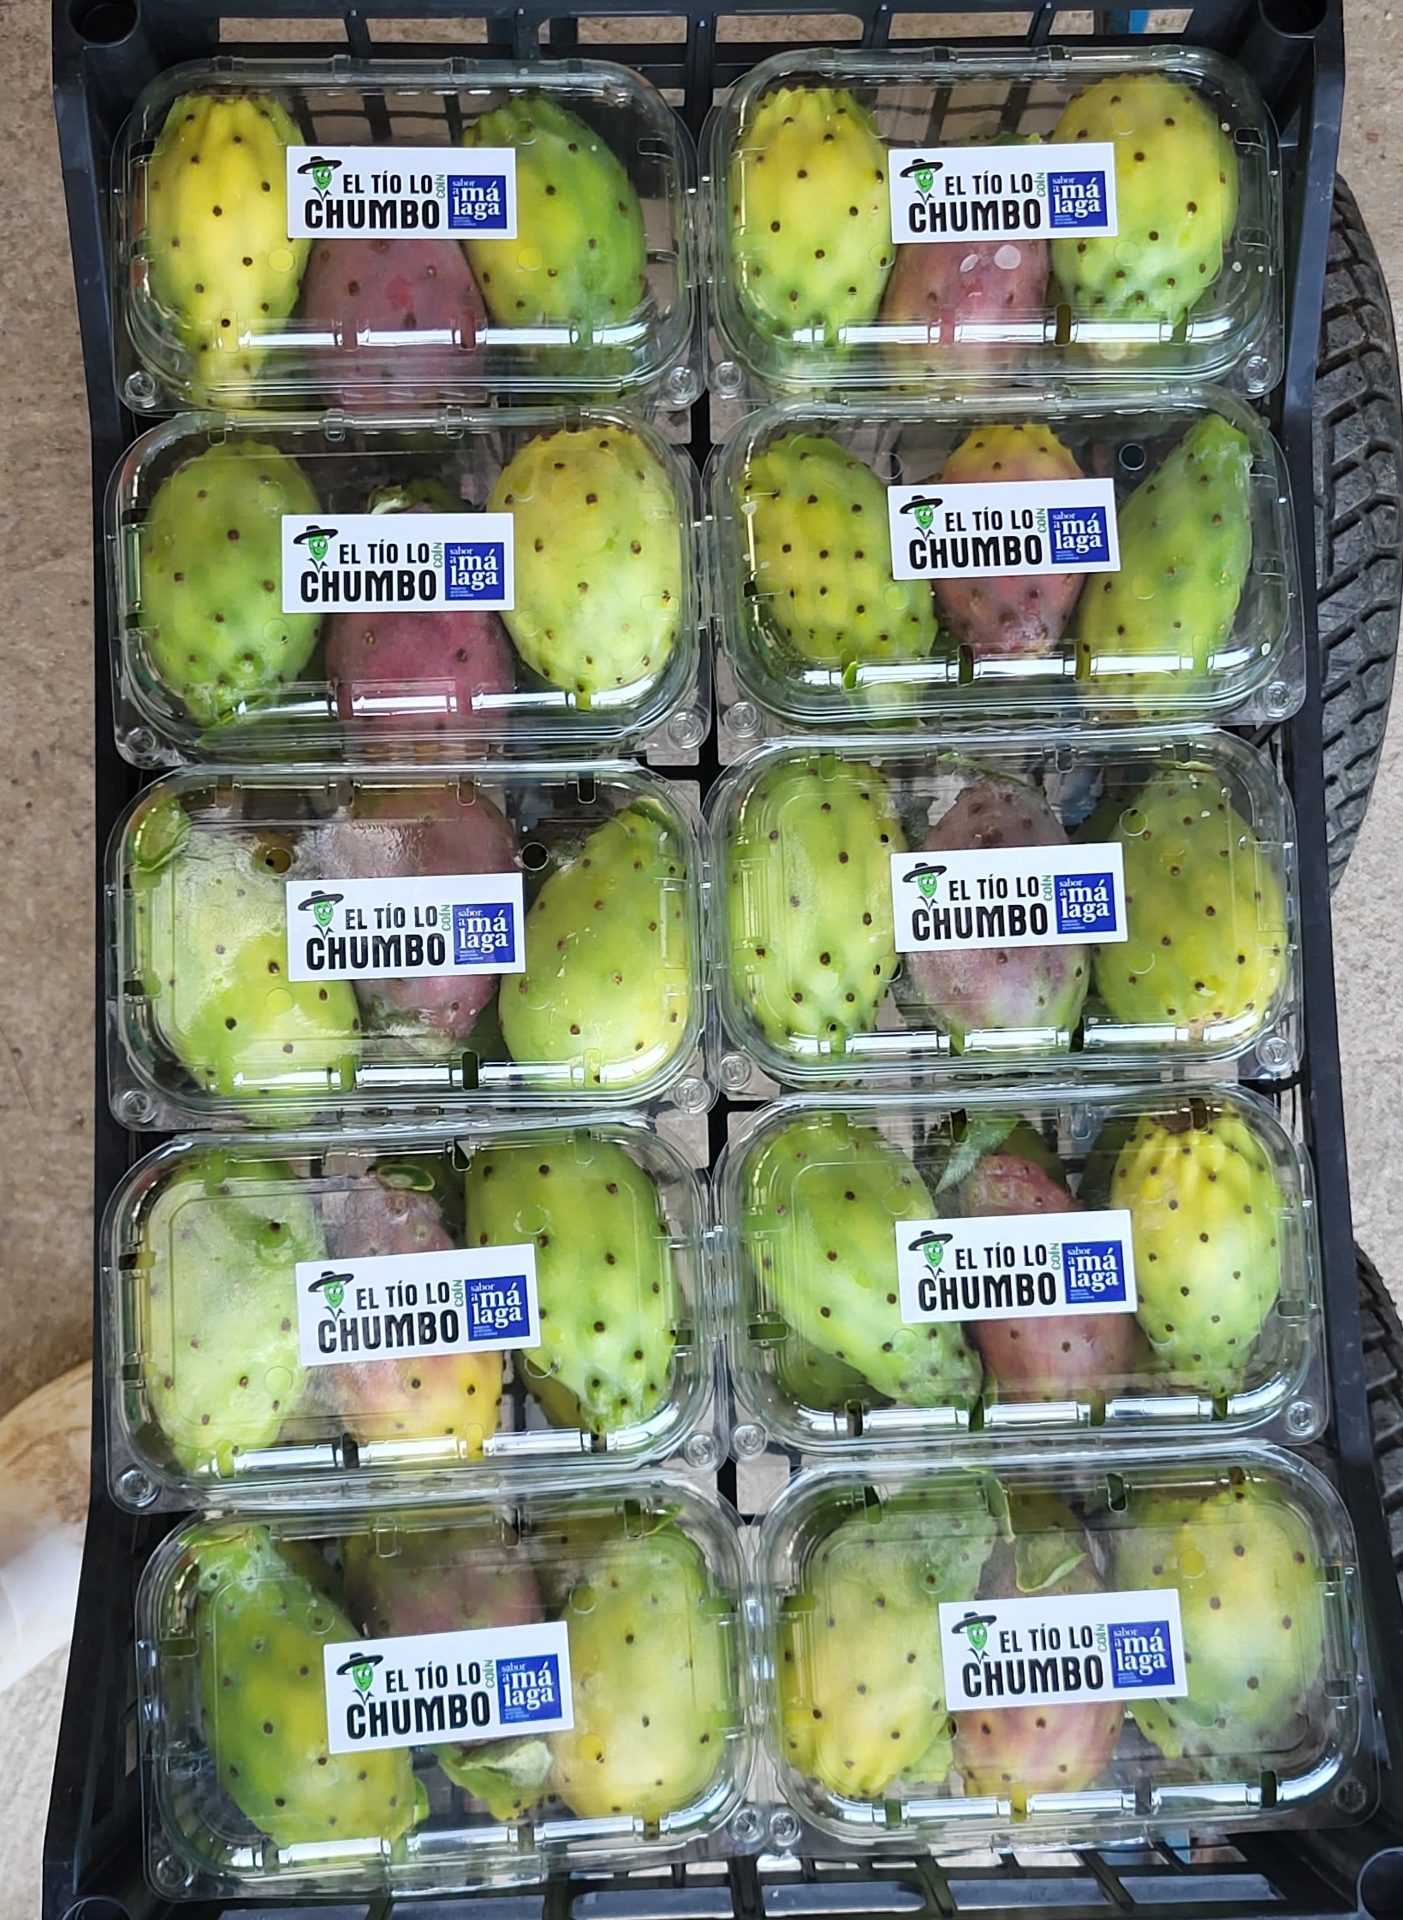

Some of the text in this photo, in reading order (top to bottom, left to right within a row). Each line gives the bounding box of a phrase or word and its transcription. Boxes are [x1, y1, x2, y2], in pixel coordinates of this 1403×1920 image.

[343, 170, 433, 194] EL TÍO LO
[453, 178, 475, 187] sabor
[945, 170, 1033, 196] EL TÍO LO
[1052, 175, 1075, 184] sabor
[305, 199, 440, 229] CHUMBO
[453, 195, 501, 221] laga
[908, 198, 1041, 233] CHUMBO
[1054, 191, 1101, 218] laga
[945, 506, 1034, 532] EL TÍO LO
[1053, 511, 1075, 520] sabor
[339, 539, 430, 565] EL TÍO LO
[450, 546, 473, 555] sabor
[909, 534, 1043, 570] CHUMBO
[1054, 527, 1103, 554] laga
[300, 569, 437, 603] CHUMBO
[450, 563, 498, 591] laga
[948, 874, 1039, 901] EL TÍO LO
[1059, 878, 1082, 887] sabor
[345, 903, 438, 930] EL TÍO LO
[458, 908, 482, 917] sabor
[912, 903, 1048, 941] CHUMBO
[1061, 894, 1110, 923] laga
[306, 933, 446, 971] CHUMBO
[459, 924, 508, 954] laga
[955, 1242, 1047, 1270] EL TÍO LO
[1067, 1246, 1091, 1255] sabor
[471, 1282, 494, 1292] sabor
[1069, 1263, 1119, 1292] laga
[356, 1280, 450, 1311] EL TÍO LO
[918, 1272, 1057, 1312] CHUMBO
[472, 1298, 523, 1329] laga
[318, 1309, 459, 1354] CHUMBO
[999, 1623, 1093, 1654] EL TÍO LO
[1114, 1627, 1137, 1637] sabor
[502, 1662, 525, 1672] sabor
[1116, 1644, 1167, 1676] laga
[385, 1661, 481, 1694] EL TÍO LO
[962, 1654, 1104, 1698] CHUMBO
[503, 1678, 555, 1711] laga
[346, 1691, 491, 1740] CHUMBO
